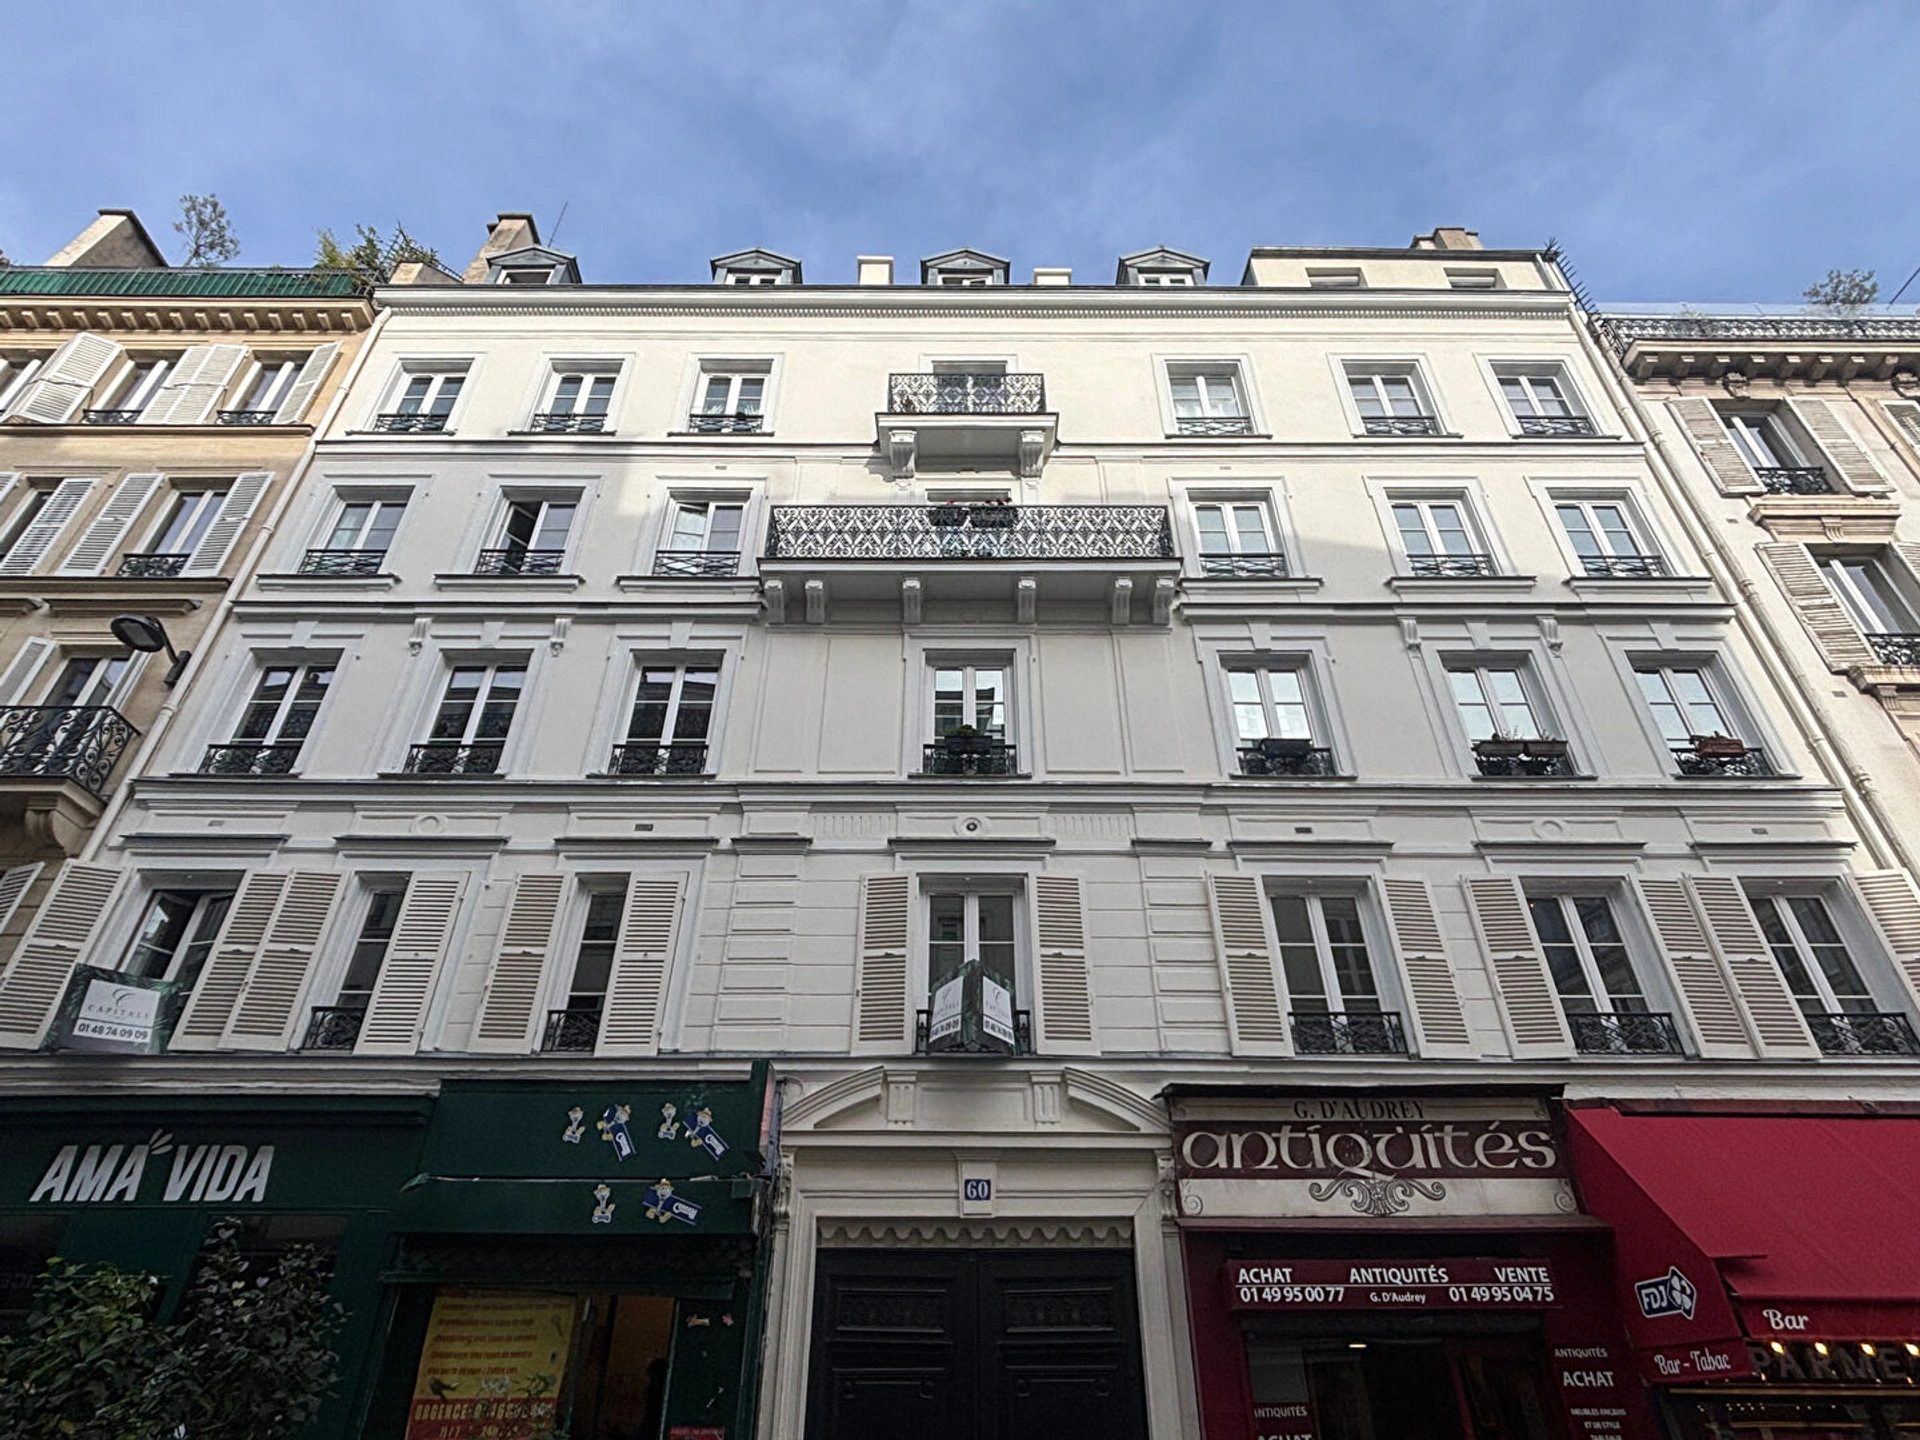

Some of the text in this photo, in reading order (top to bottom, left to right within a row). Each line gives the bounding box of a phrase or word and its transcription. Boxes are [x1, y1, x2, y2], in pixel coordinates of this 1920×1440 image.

[119, 1028, 133, 1038] 09
[134, 1029, 148, 1040] 09
[1293, 1100, 1424, 1119] G. D'AUDREY
[163, 1144, 275, 1202] VIDA
[966, 1181, 989, 1199] 60
[1238, 1264, 1551, 1285] ACHAT ANTIQUITÉS VENTE
[1382, 1290, 1426, 1304] D'Audrey
[1640, 1285, 1668, 1310] FDJ
[1762, 1308, 1810, 1331] Bar
[1554, 1347, 1608, 1359] ANTIQUITÉS
[1653, 1353, 1681, 1375] Bar
[1690, 1346, 1731, 1373] Tabac
[1562, 1370, 1615, 1387] ACHAT
[1253, 1404, 1308, 1418] ANTIQUITÉS
